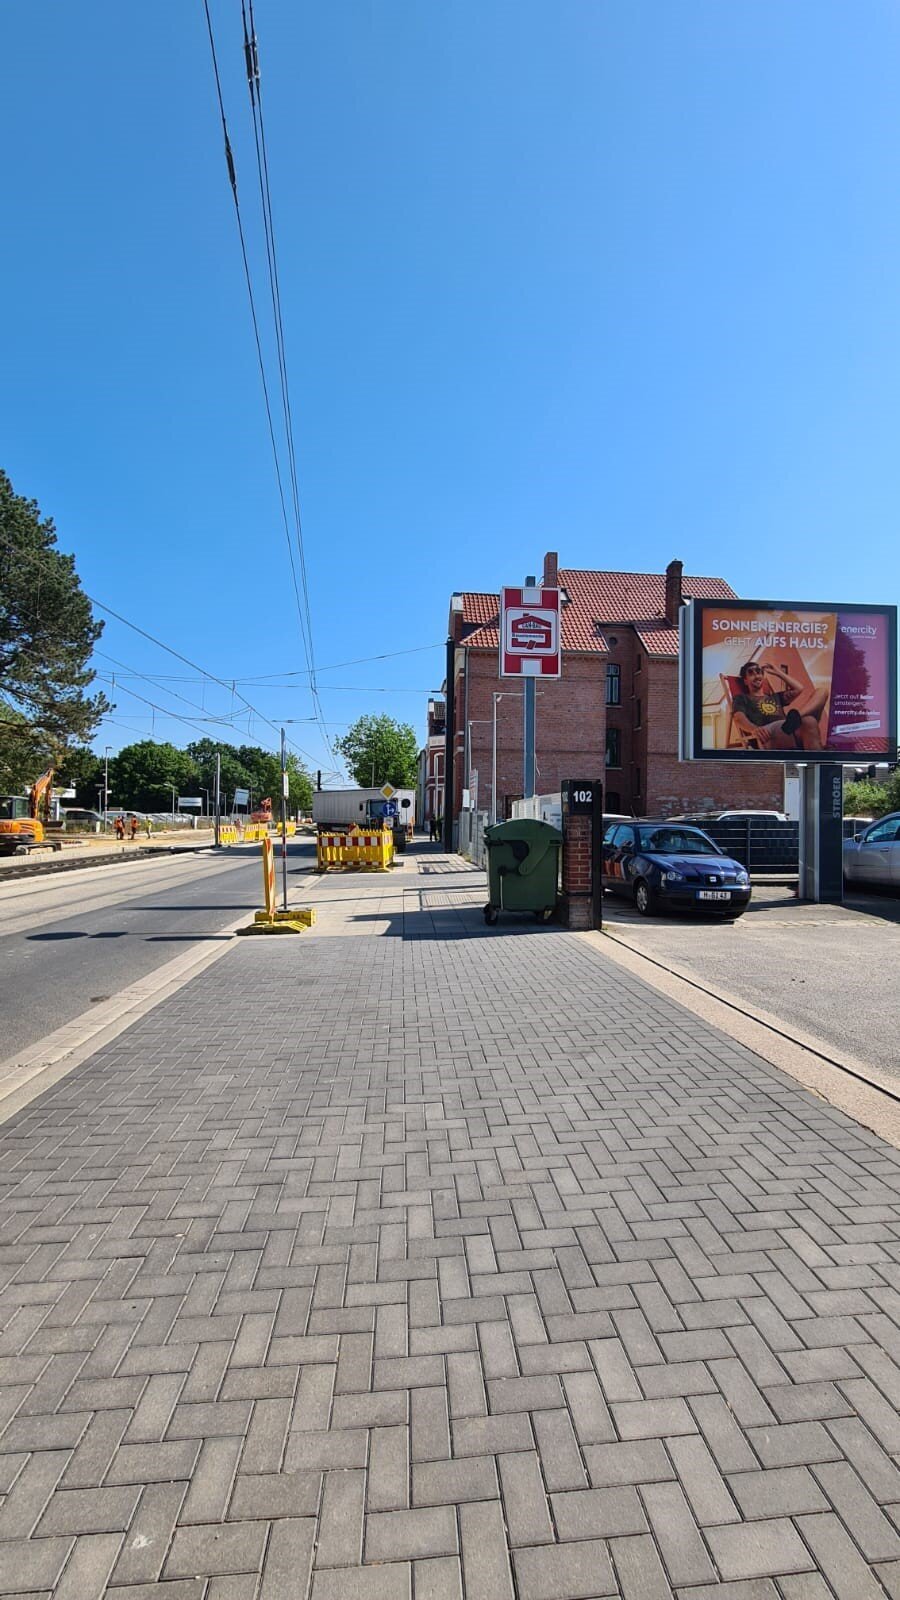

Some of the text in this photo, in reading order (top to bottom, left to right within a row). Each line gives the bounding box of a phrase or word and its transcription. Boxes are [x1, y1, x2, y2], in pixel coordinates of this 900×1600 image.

[712, 618, 829, 634] SONNENENERGIE?
[840, 623, 877, 636] enercity
[723, 636, 829, 649] GEHT AUFS HAUS.
[573, 790, 593, 803] 102
